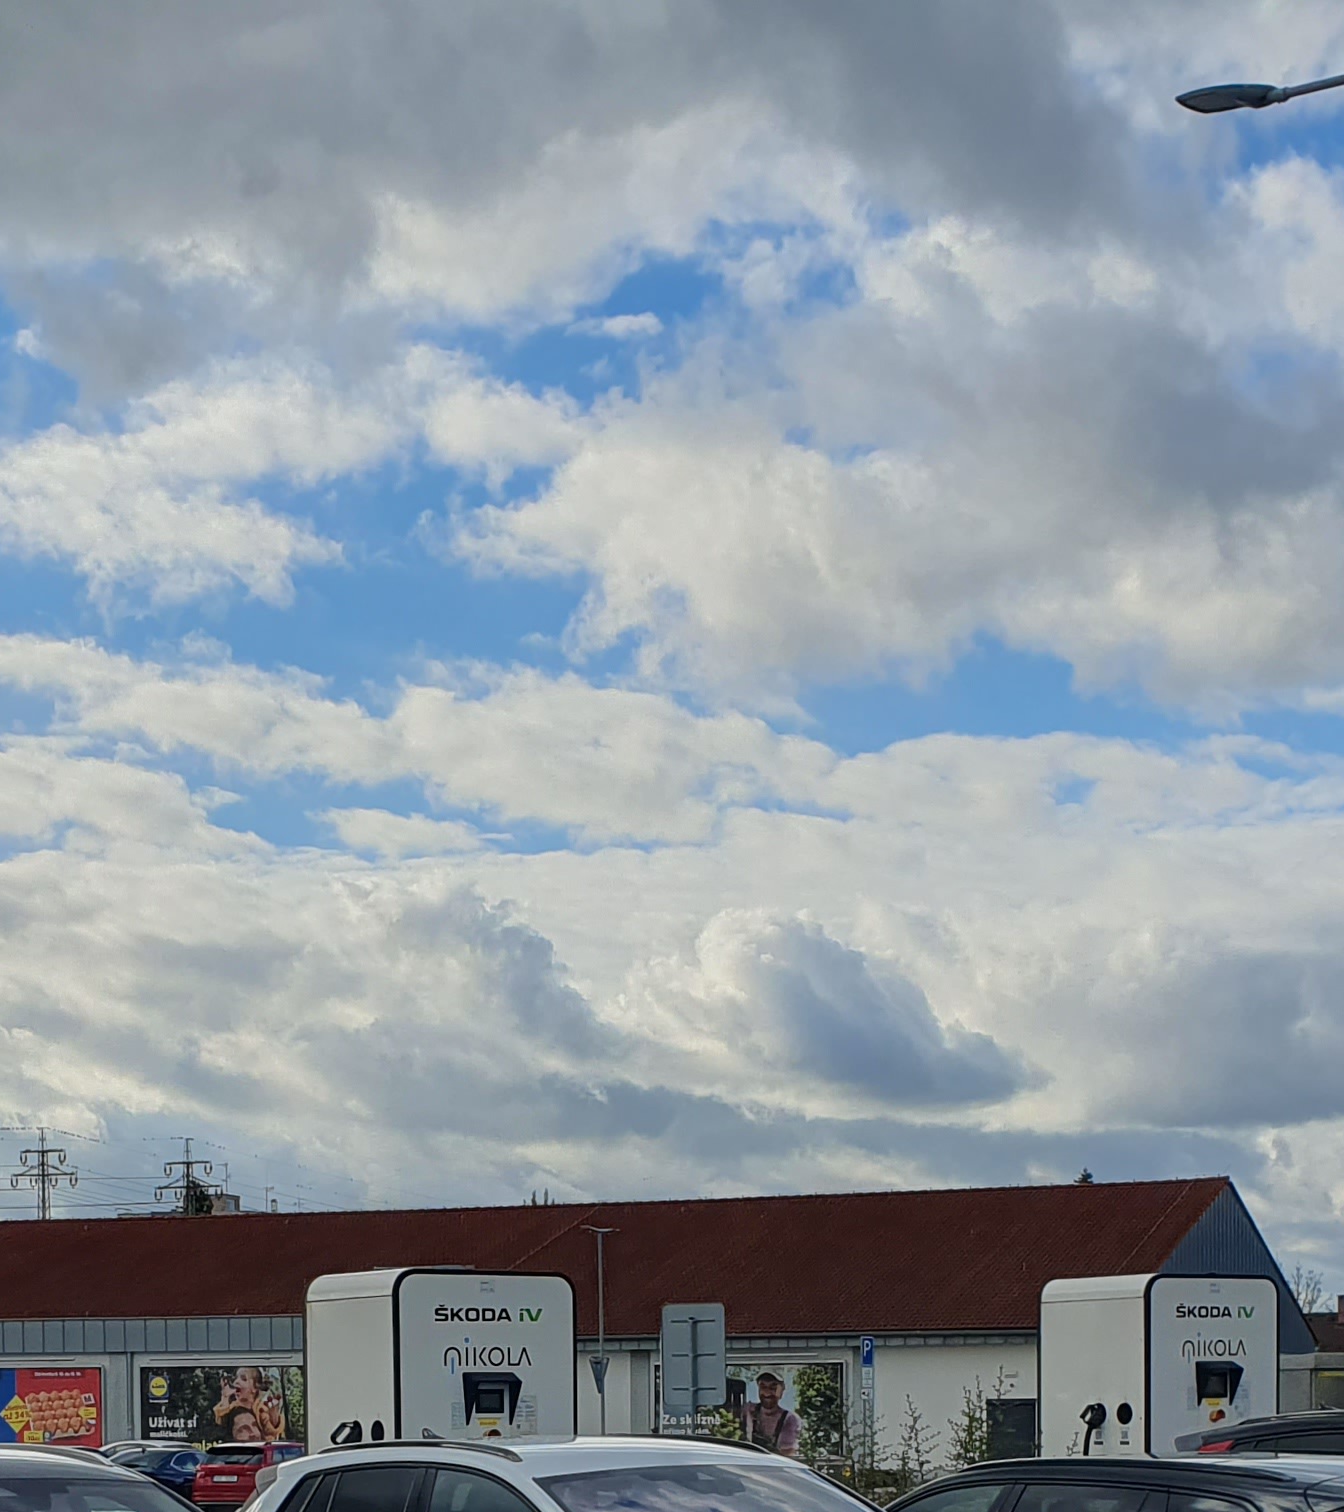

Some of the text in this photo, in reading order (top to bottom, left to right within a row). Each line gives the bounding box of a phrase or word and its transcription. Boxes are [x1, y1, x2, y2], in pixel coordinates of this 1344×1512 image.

[435, 1304, 512, 1322] ŠKODA
[1176, 1303, 1232, 1318] ŠKODA
[863, 1340, 871, 1357] P
[663, 1413, 677, 1425] Ze
